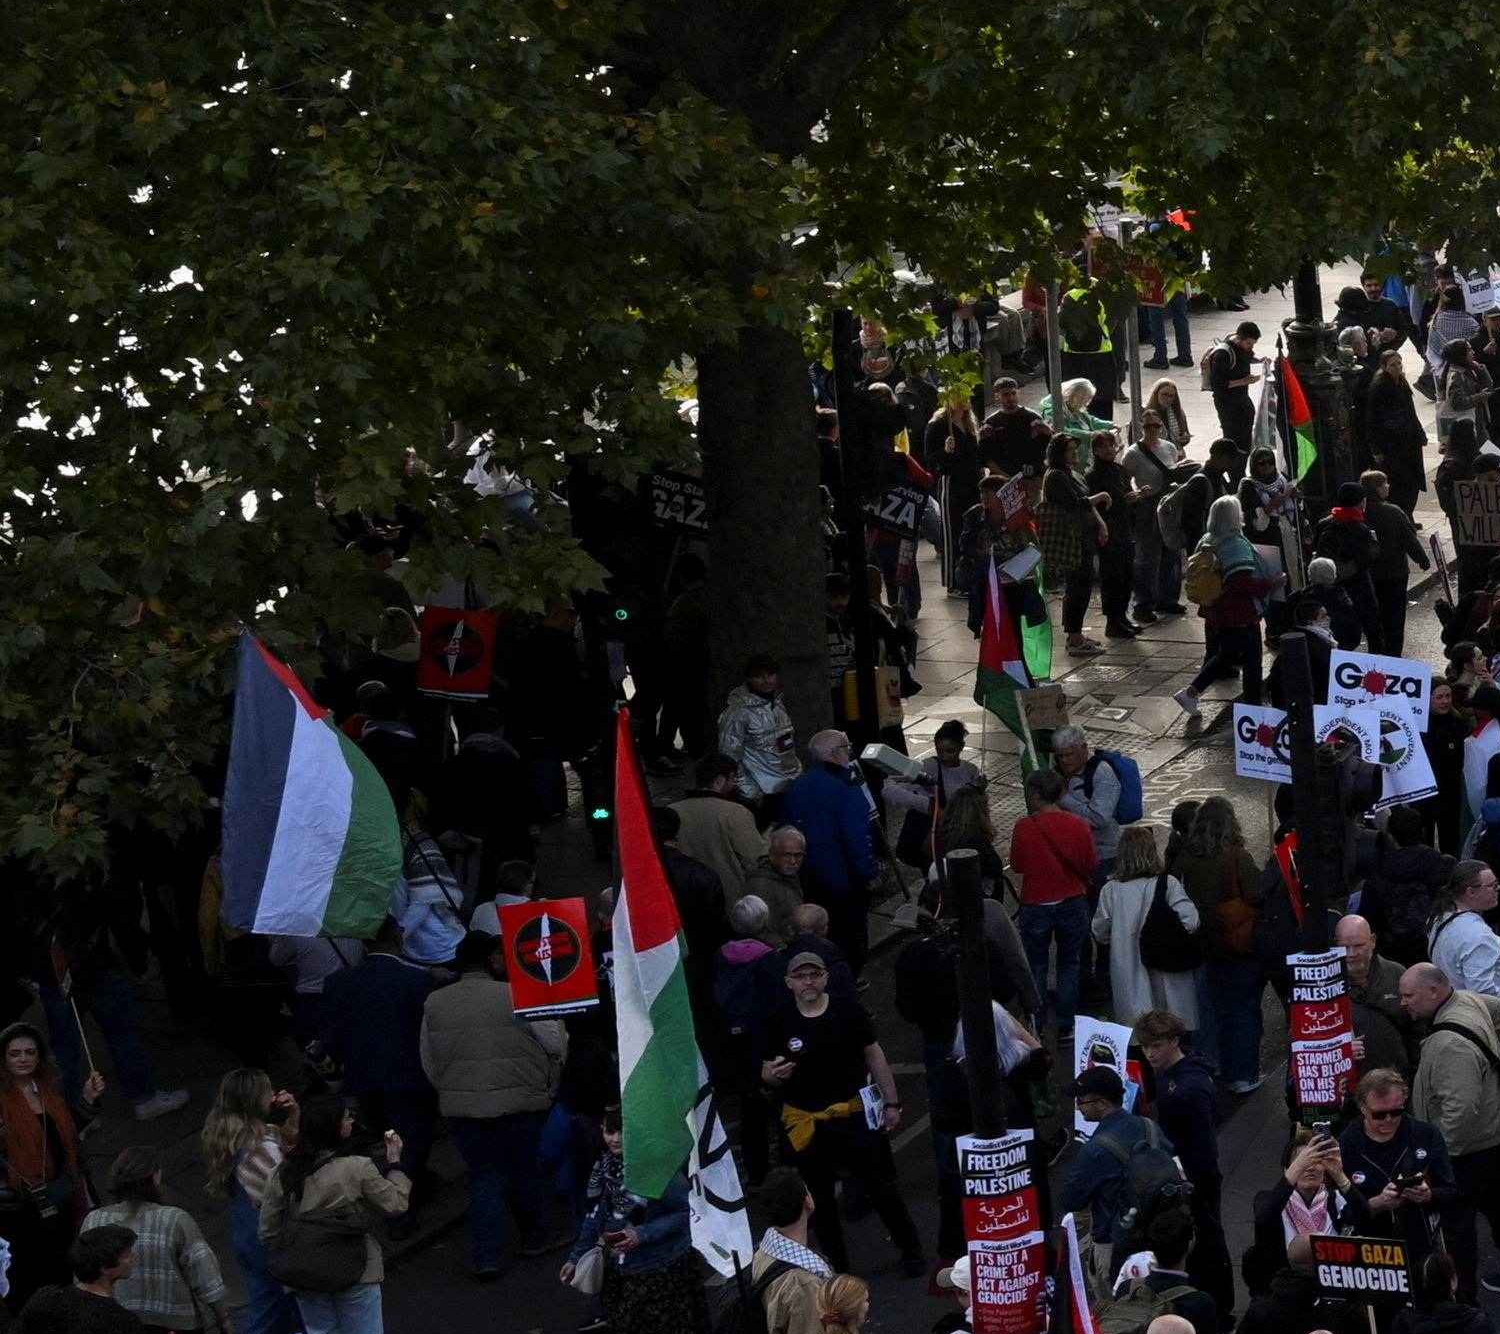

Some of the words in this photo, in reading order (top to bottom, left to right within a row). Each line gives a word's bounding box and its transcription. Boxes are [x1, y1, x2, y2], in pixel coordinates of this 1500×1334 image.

[968, 1146, 1027, 1171] FREEDOM
[965, 1168, 1032, 1196] PALESTINE
[978, 1196, 1024, 1215] الحرية
[976, 1214, 1030, 1234] لفلسطين
[1315, 1239, 1357, 1264] STOP
[1361, 1240, 1405, 1267] GAZA
[1318, 1264, 1410, 1293] GENOCIDE
